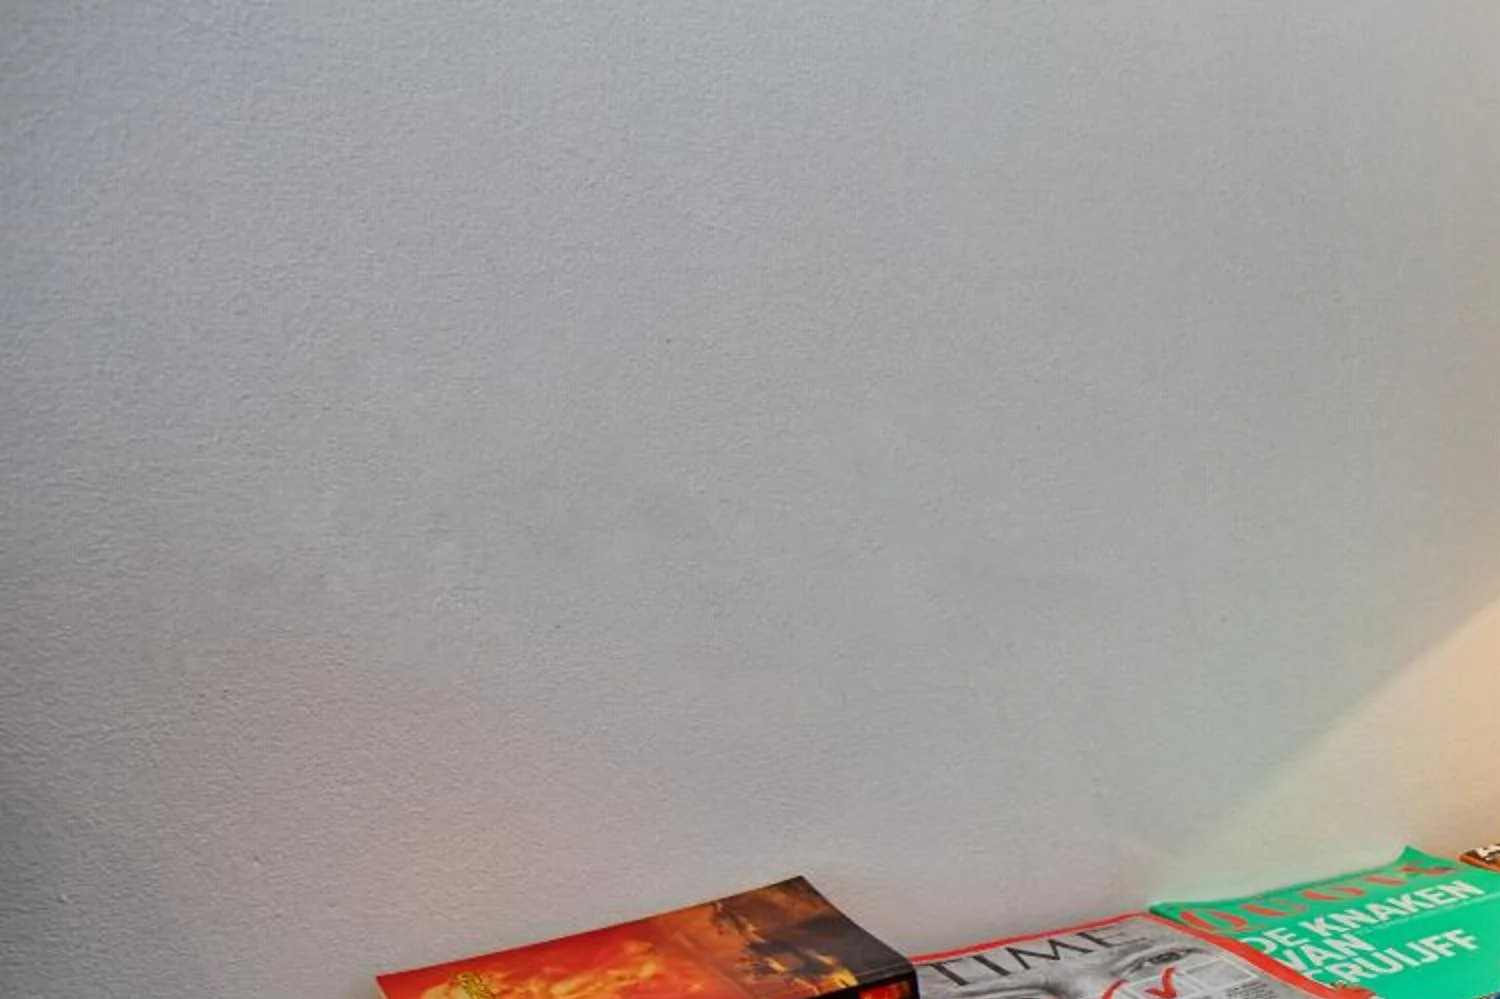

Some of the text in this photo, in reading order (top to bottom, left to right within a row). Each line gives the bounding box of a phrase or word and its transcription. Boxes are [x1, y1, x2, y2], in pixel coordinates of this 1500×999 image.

[1299, 880, 1485, 937] KNAKEN
[927, 926, 1150, 985] TIME
[1274, 933, 1376, 970] VAN
